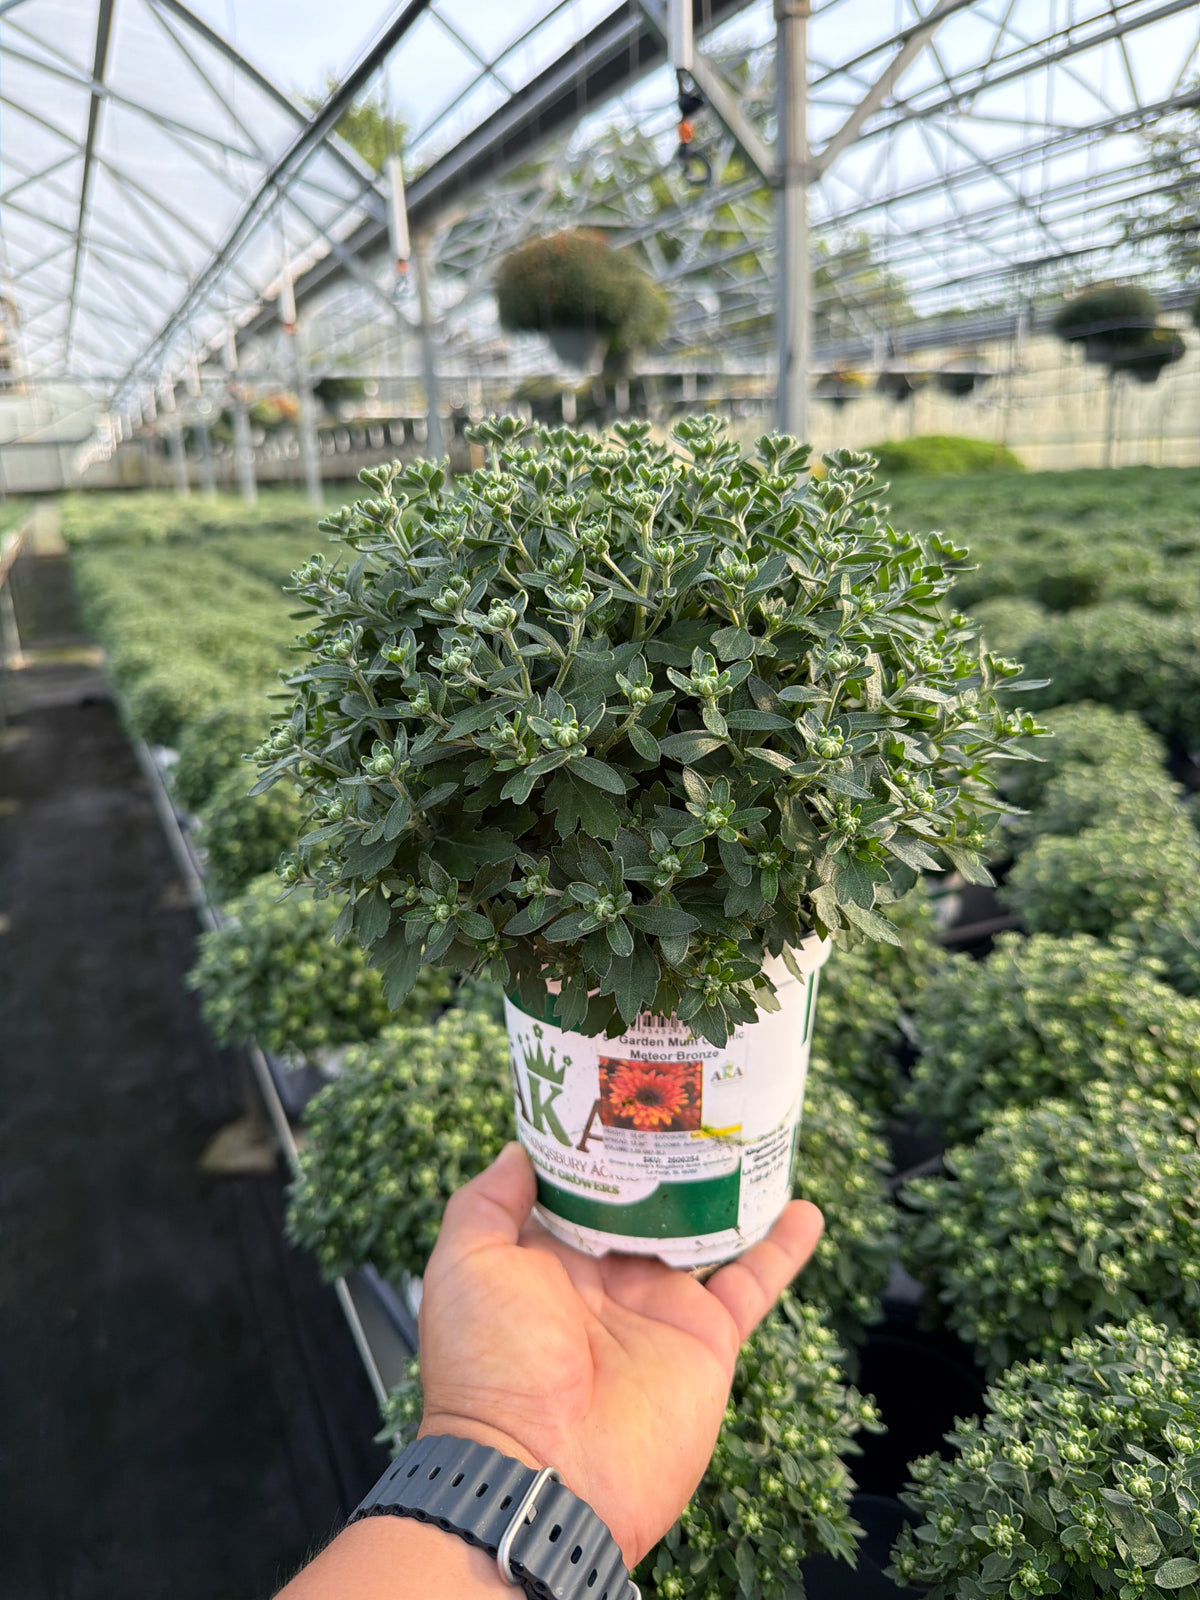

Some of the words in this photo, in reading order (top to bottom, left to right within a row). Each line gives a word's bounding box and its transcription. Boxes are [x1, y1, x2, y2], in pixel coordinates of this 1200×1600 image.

[619, 1034, 664, 1047] Garden
[668, 1036, 698, 1047] Mum
[630, 1049, 673, 1060] Meteor
[676, 1050, 719, 1060] Bronze
[557, 1168, 620, 1195] GROWERS
